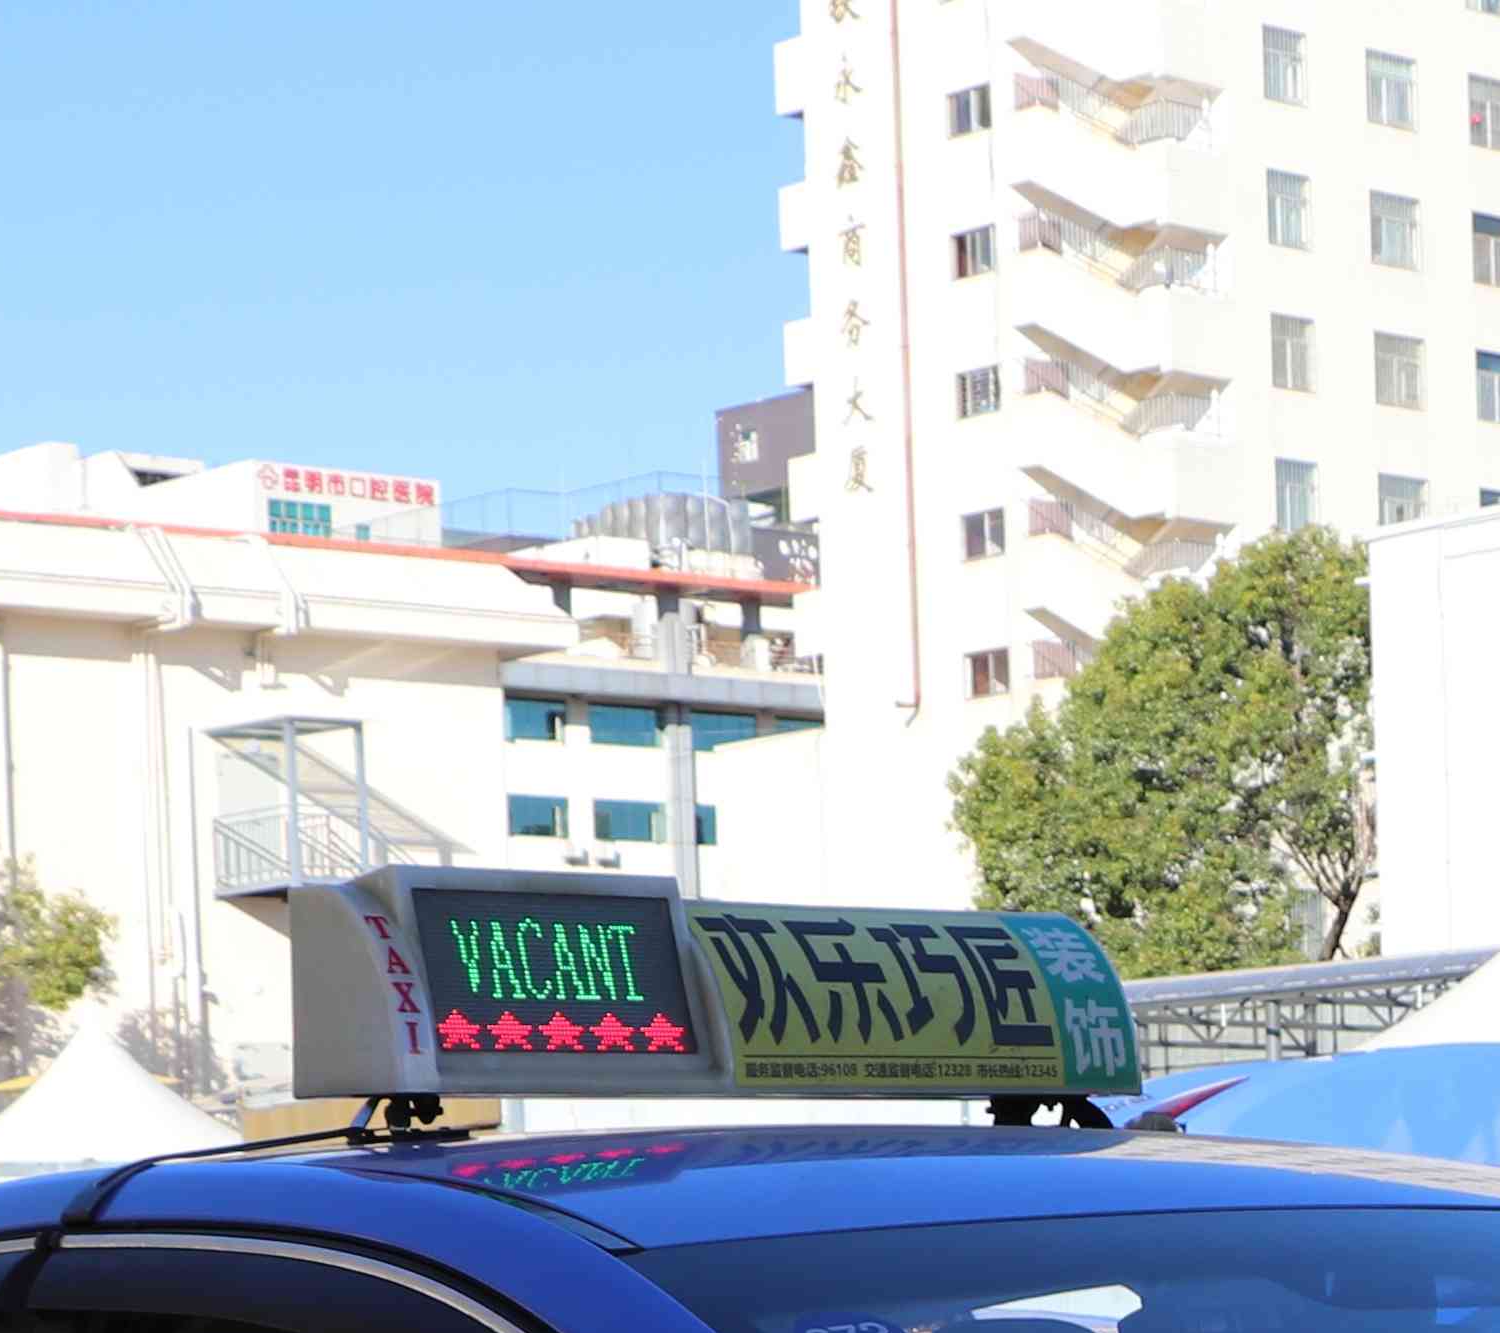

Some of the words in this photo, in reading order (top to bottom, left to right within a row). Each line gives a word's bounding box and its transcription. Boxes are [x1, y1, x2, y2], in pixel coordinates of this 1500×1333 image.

[363, 914, 422, 1056] TAXI
[450, 917, 645, 1001] VACANT
[693, 912, 1055, 1047] 欢乐巧匠
[1021, 926, 1127, 1078] 装饰
